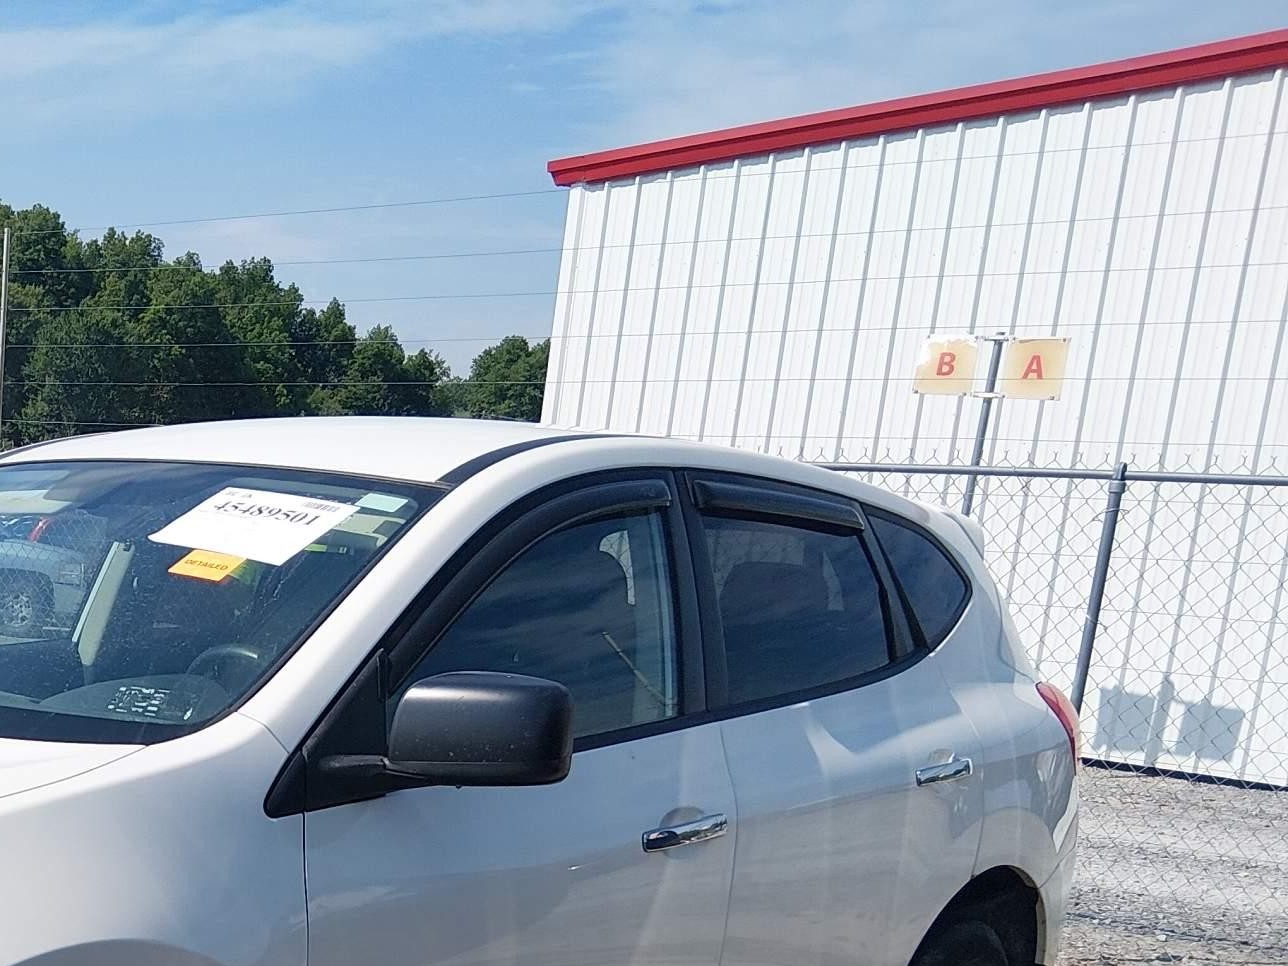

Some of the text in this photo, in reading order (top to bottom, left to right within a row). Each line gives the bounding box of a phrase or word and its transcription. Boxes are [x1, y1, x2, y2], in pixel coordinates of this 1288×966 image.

[936, 352, 957, 376] B
[1022, 355, 1044, 380] A
[214, 500, 321, 526] 45489501
[184, 559, 229, 571] DETAILED
